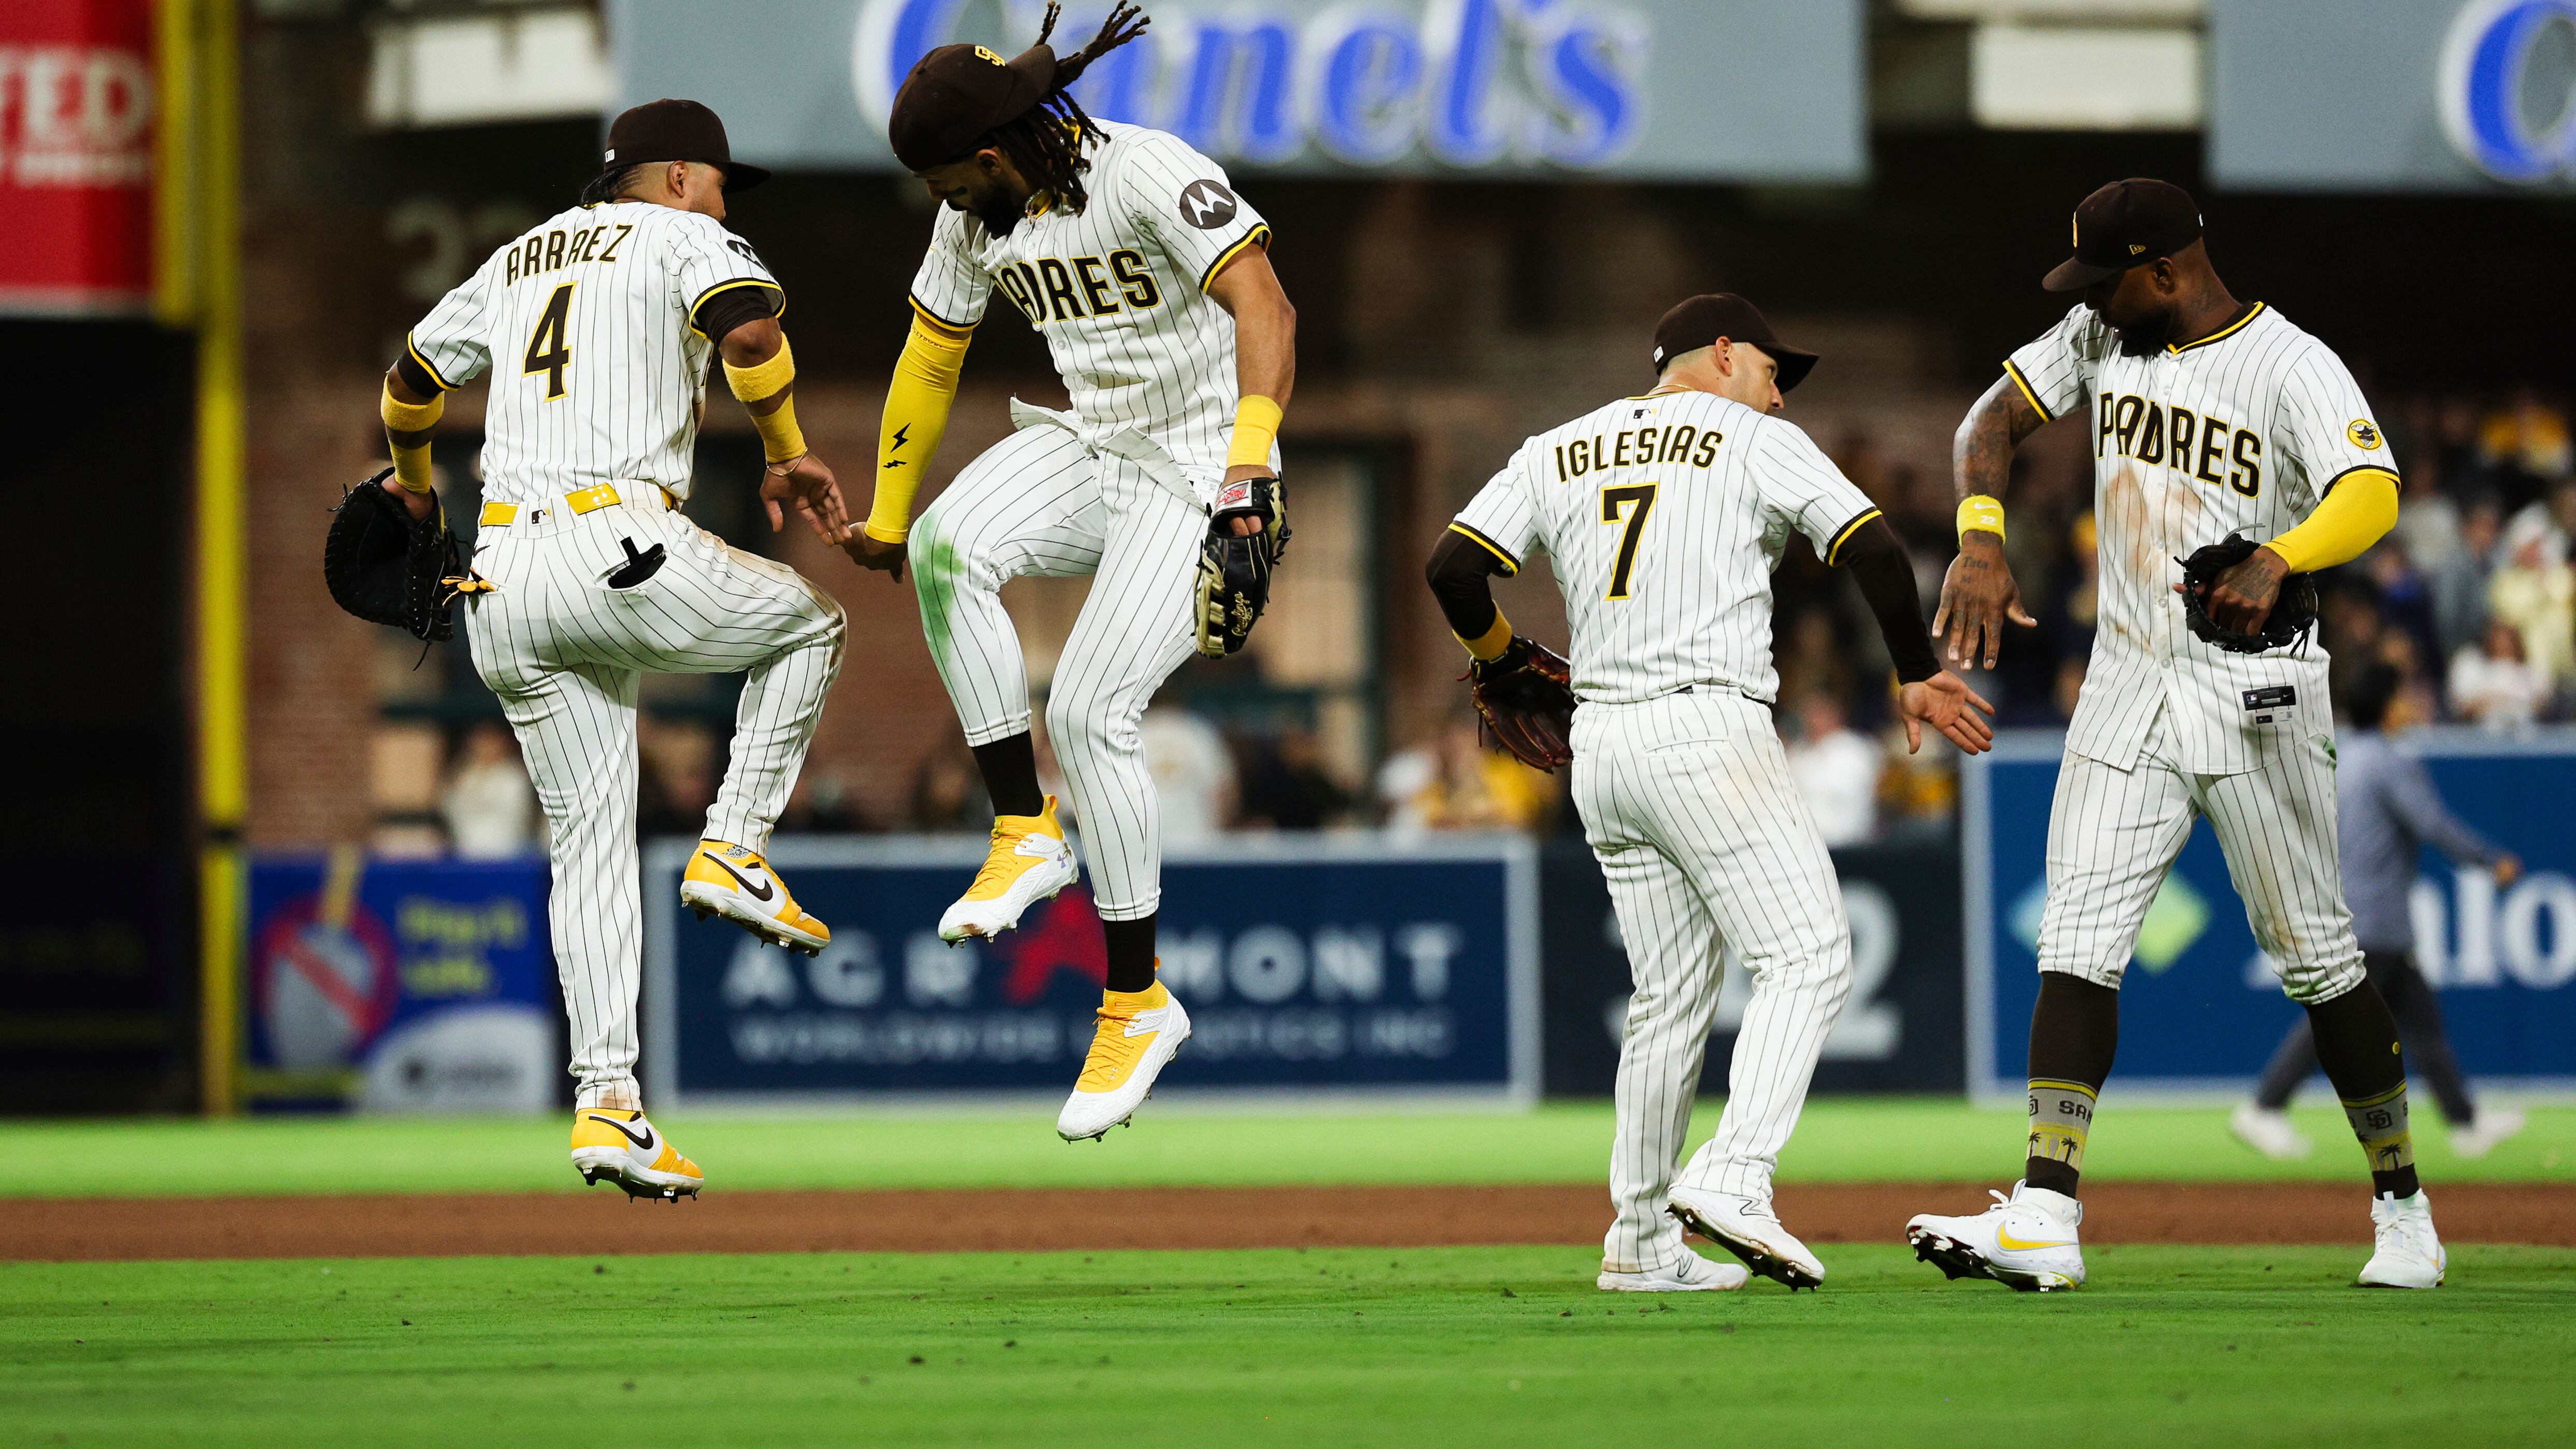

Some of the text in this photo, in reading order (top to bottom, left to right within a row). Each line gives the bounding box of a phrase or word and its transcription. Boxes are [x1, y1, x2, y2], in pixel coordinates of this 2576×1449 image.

[506, 224, 633, 287] ARRAEZ
[989, 248, 1160, 323] ADRES
[523, 280, 578, 403] 4
[1555, 424, 1724, 483] IGLESIAS
[2097, 392, 2262, 499] PADRES
[1600, 481, 1659, 601] 7
[1980, 514, 1996, 526] 22
